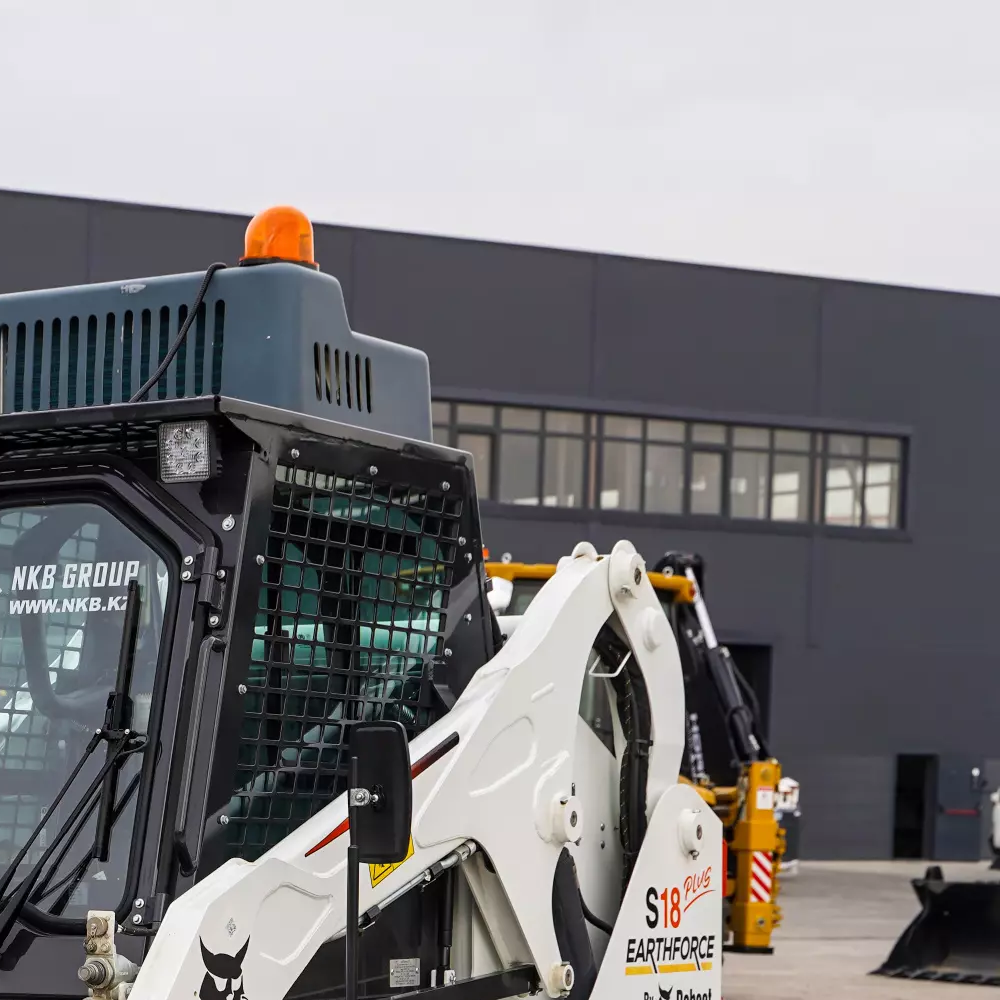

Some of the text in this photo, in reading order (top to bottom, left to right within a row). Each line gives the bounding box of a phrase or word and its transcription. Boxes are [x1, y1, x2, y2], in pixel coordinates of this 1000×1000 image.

[11, 560, 140, 591] NKB GROUP
[645, 866, 712, 929] S18 PLUS
[626, 935, 715, 974] EARTHFORCE
